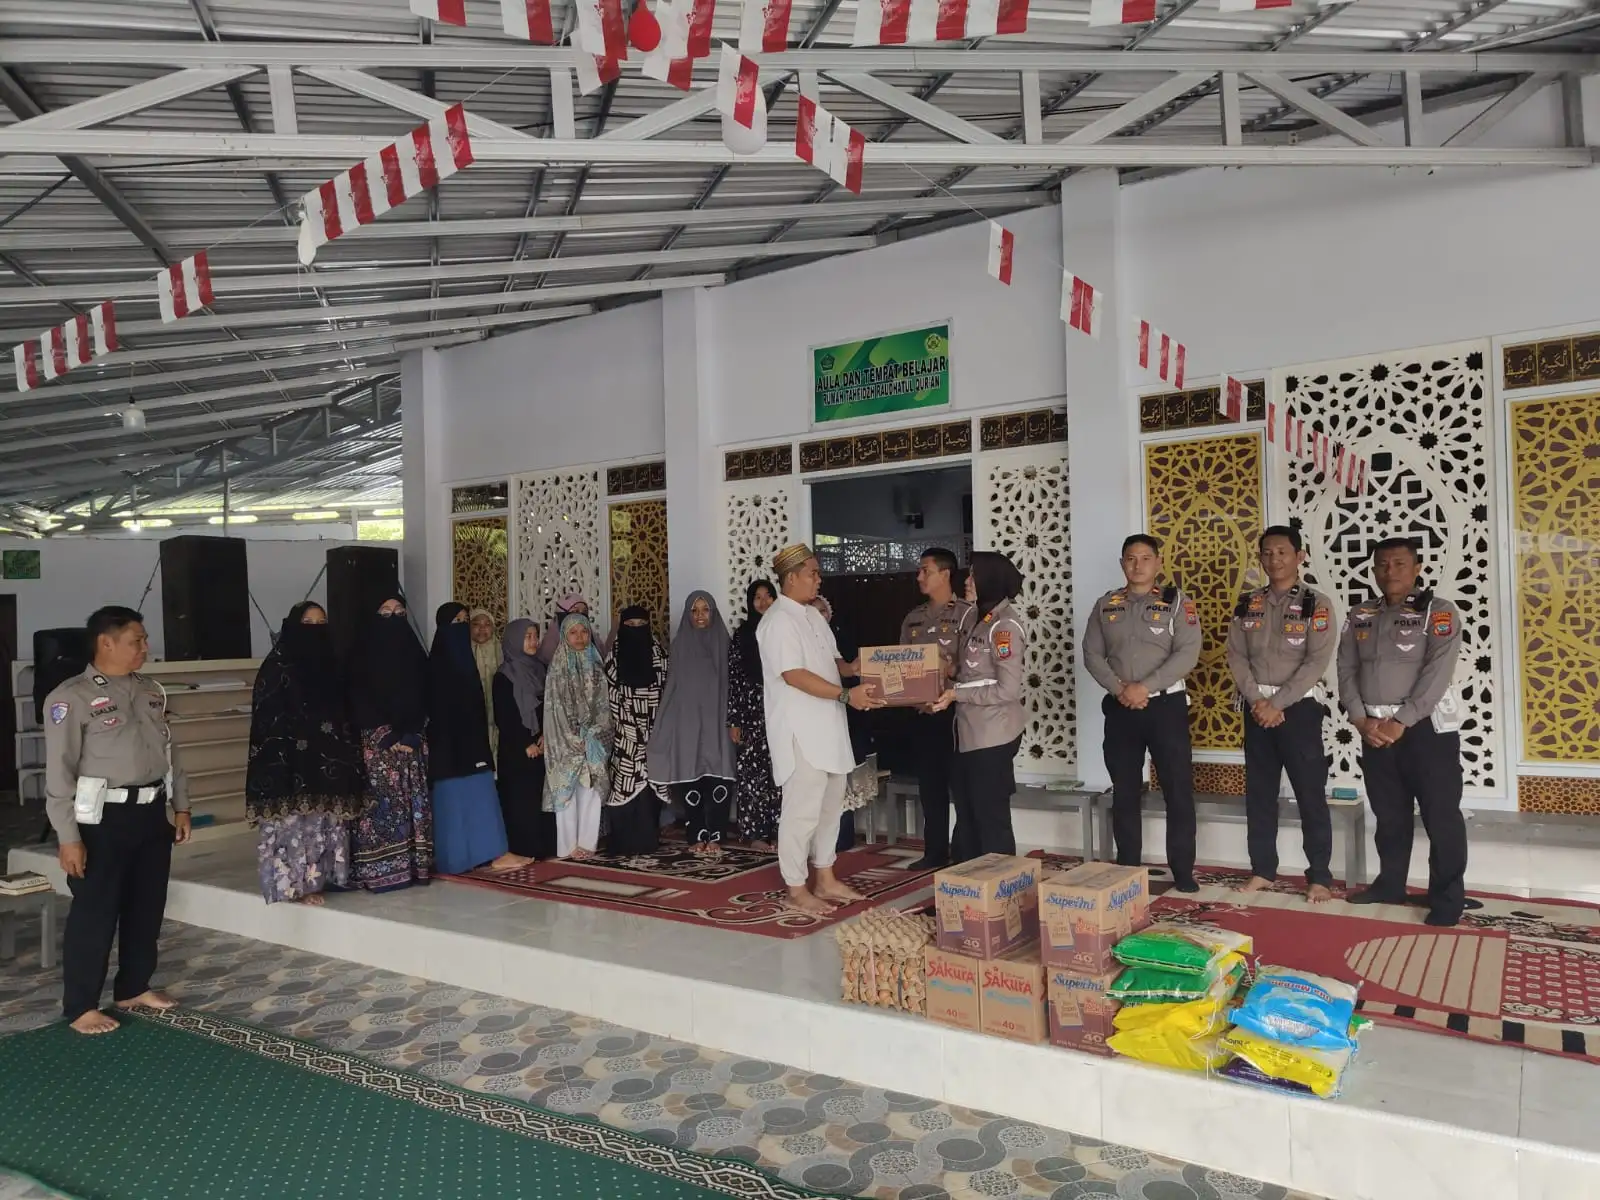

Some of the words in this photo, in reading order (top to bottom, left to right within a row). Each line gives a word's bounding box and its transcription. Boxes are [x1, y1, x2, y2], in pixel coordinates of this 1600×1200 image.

[817, 374, 840, 392] AULA
[843, 369, 861, 387] DAN
[863, 363, 900, 384] TEMPAT
[902, 355, 946, 377] BELAJAR
[823, 390, 844, 406] RUMAH
[963, 938, 980, 948] 40
[1073, 953, 1093, 962] 40
[946, 1008, 958, 1017] 40
[1002, 1020, 1015, 1030] 40
[1083, 1033, 1102, 1043] 40
